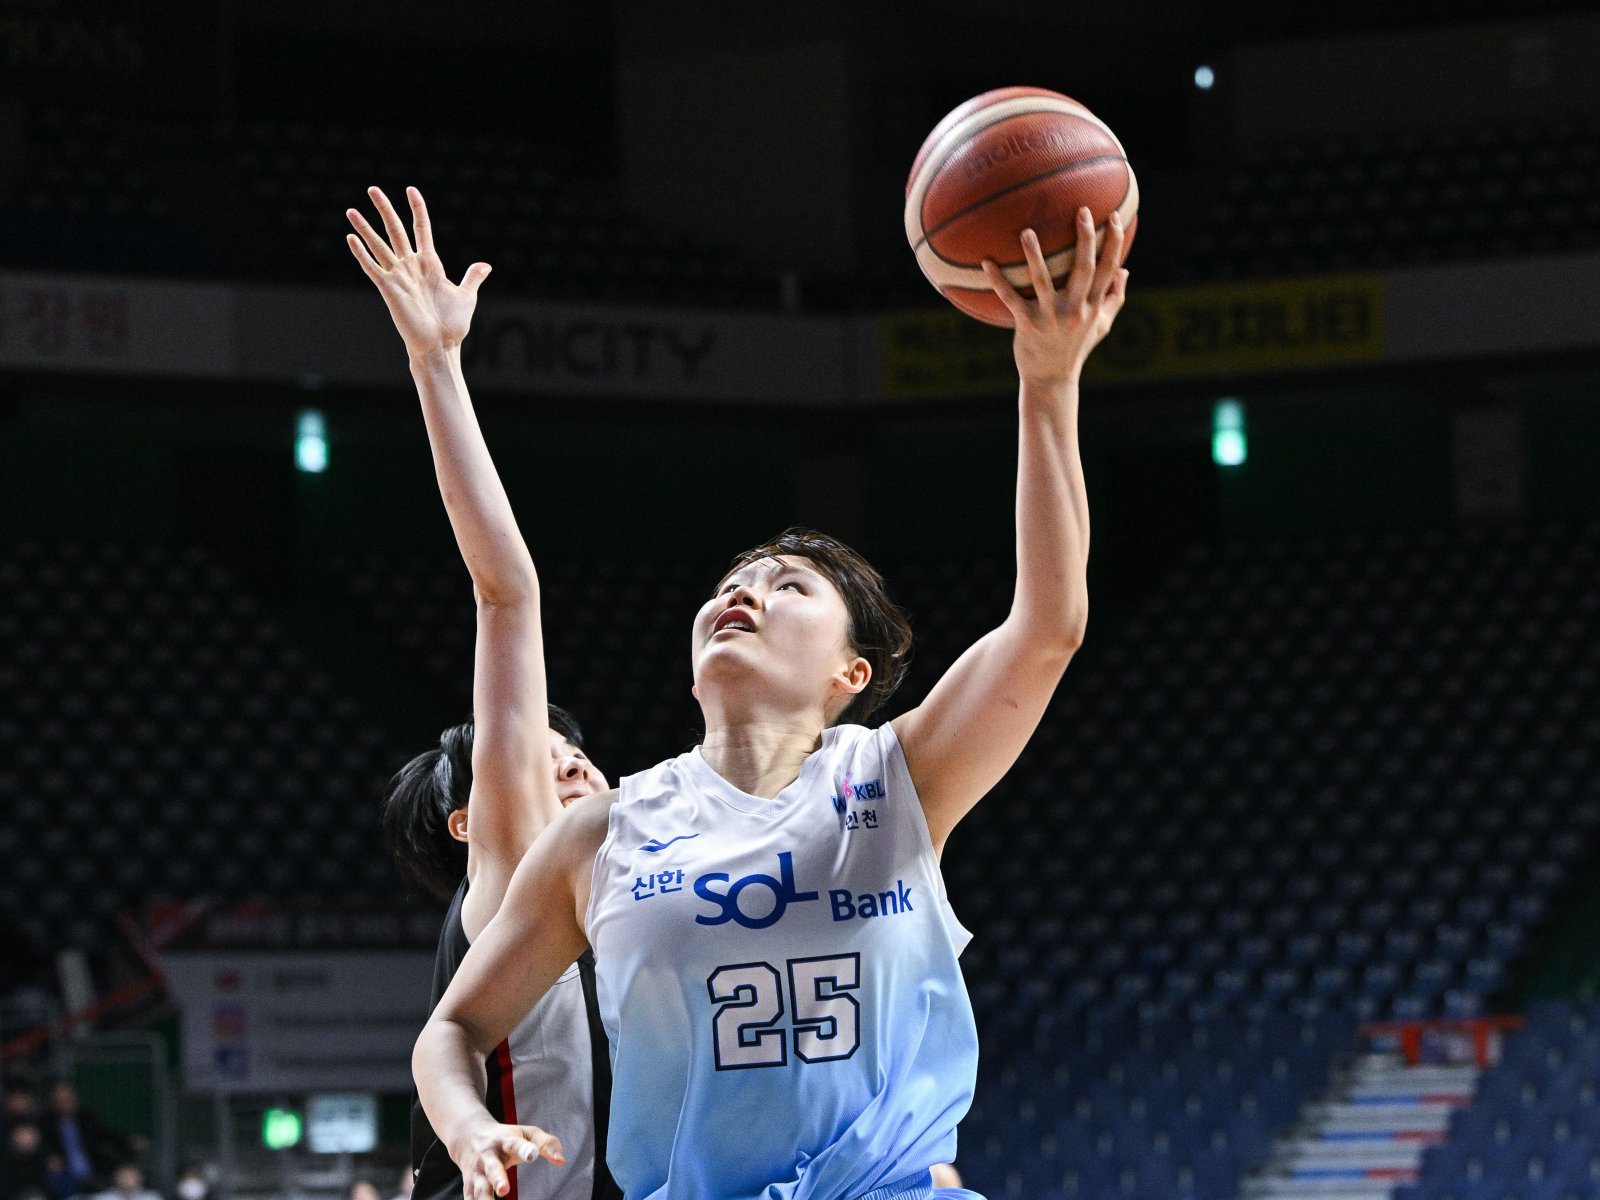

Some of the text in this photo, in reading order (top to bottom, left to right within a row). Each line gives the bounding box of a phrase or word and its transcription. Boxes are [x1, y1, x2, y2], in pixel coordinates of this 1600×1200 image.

[846, 810, 879, 830] 인천
[631, 851, 914, 929] 신한 SOL Bank
[706, 952, 861, 1072] 25
